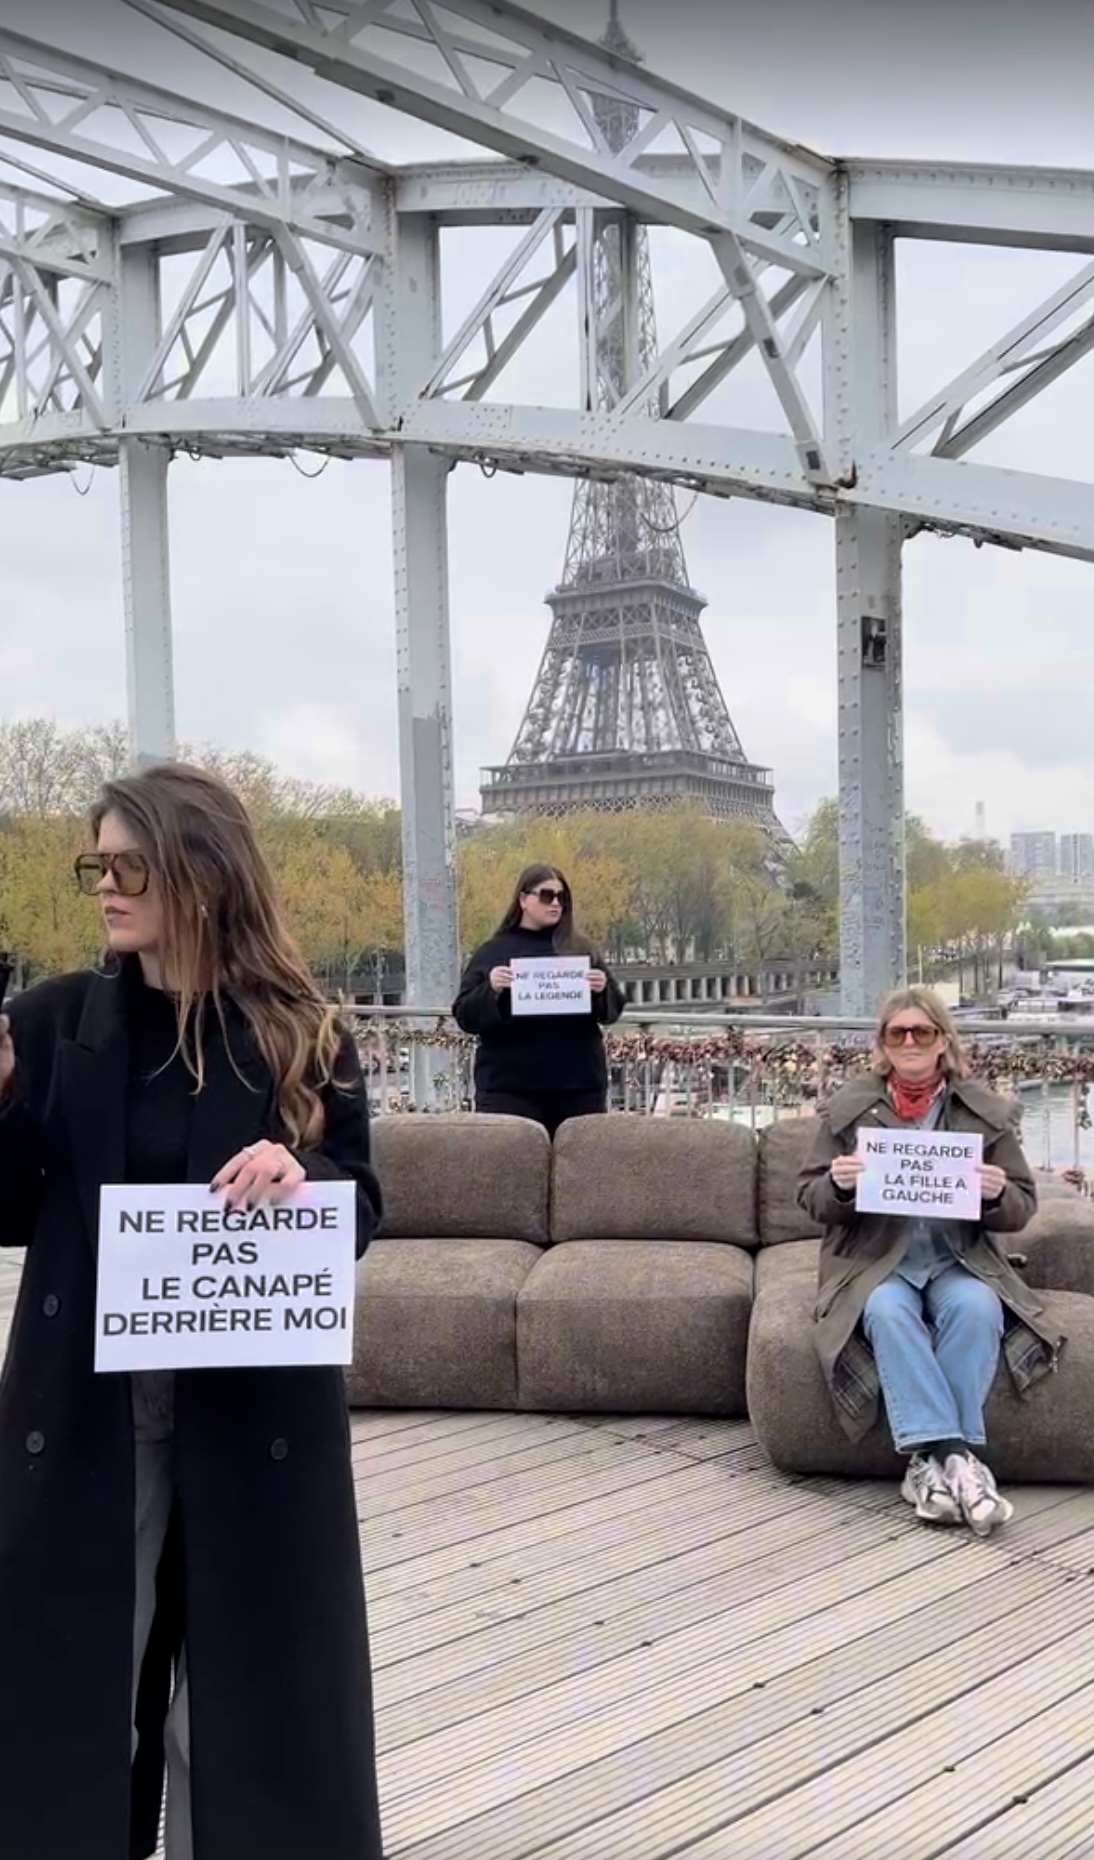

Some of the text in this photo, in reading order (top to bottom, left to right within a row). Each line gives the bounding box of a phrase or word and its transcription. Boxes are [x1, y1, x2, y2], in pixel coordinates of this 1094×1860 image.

[866, 1142, 973, 1158] NE REGARDE
[901, 1160, 933, 1171] PAS
[885, 1174, 904, 1185] LA
[910, 1176, 952, 1188] FILLE
[882, 1189, 953, 1204] GAUCHE
[119, 1207, 338, 1233] NE REGARDE
[191, 1242, 258, 1265] PAS
[143, 1268, 332, 1300] LE CANAPÉ
[103, 1304, 346, 1336] DERRIÈRE MOI
